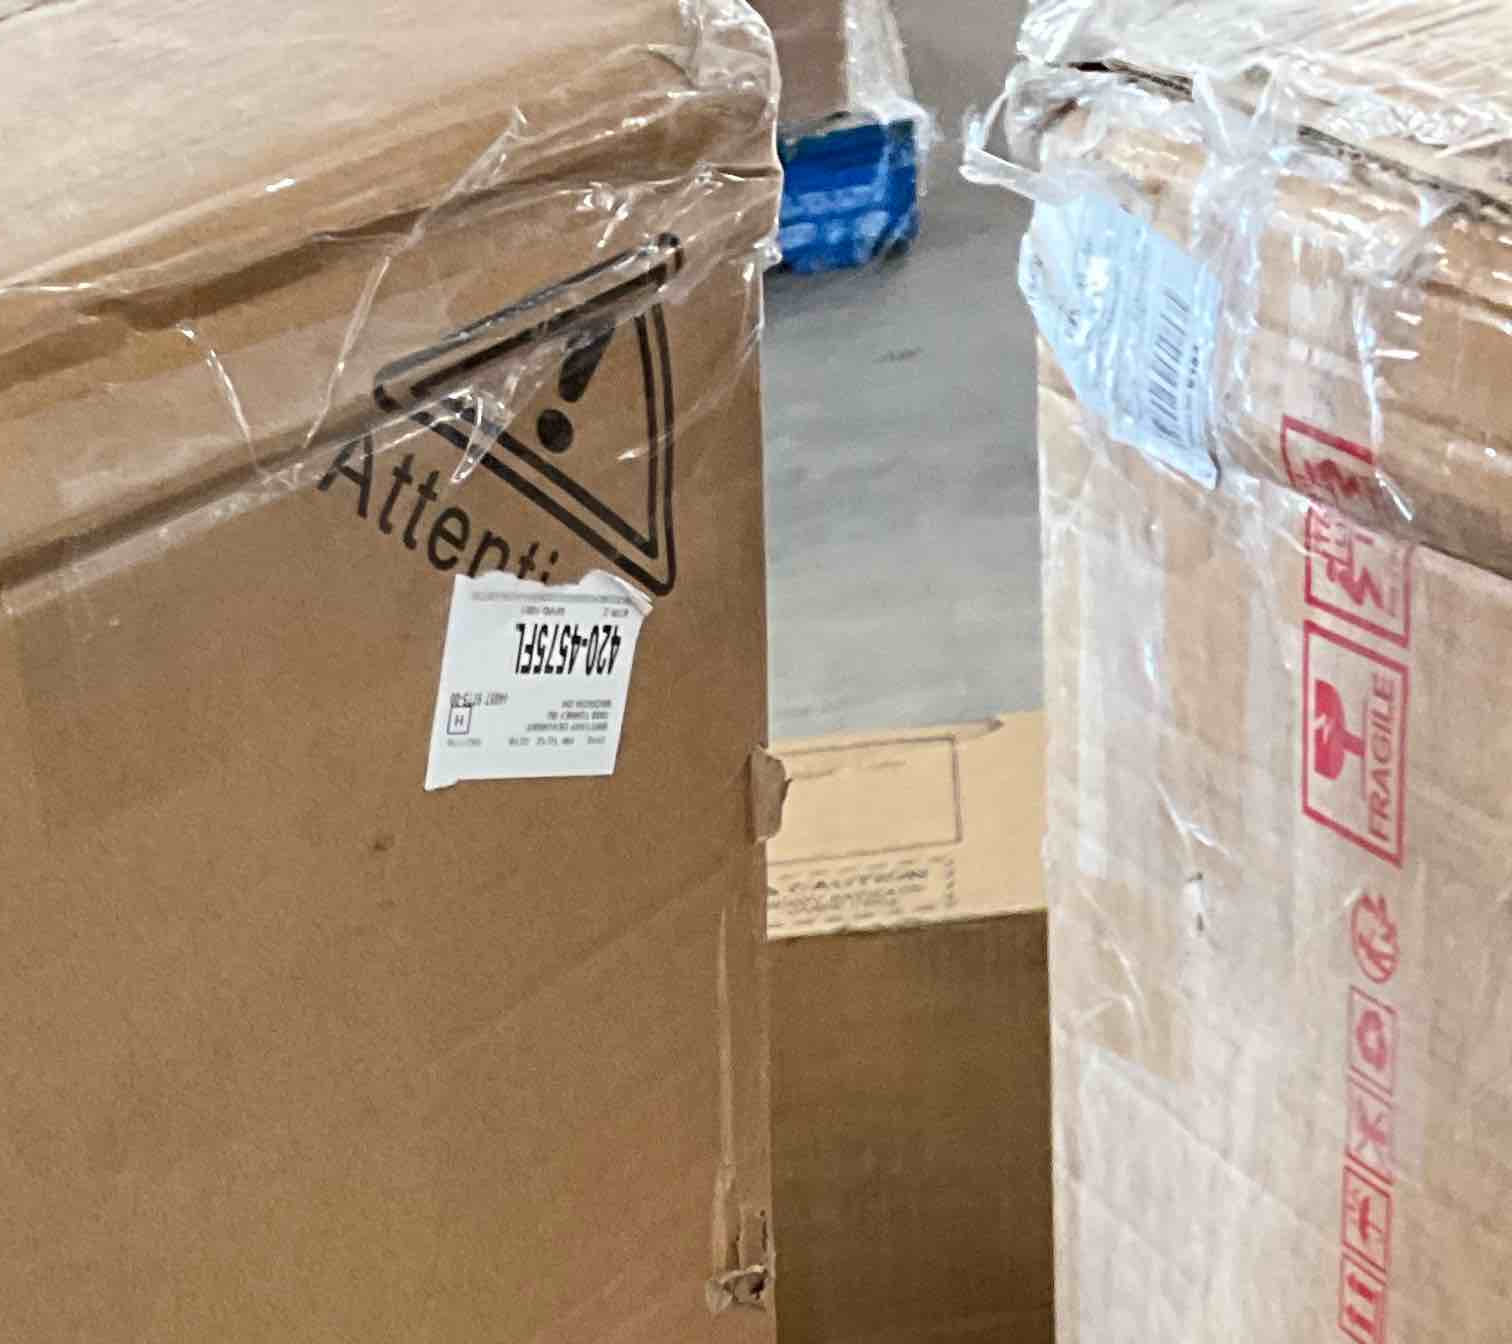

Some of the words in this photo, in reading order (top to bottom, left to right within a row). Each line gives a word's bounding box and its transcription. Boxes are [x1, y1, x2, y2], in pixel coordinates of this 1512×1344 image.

[317, 433, 559, 584] Attenti
[515, 621, 622, 675] 420-4575FL
[1368, 672, 1397, 843] FRAGILE
